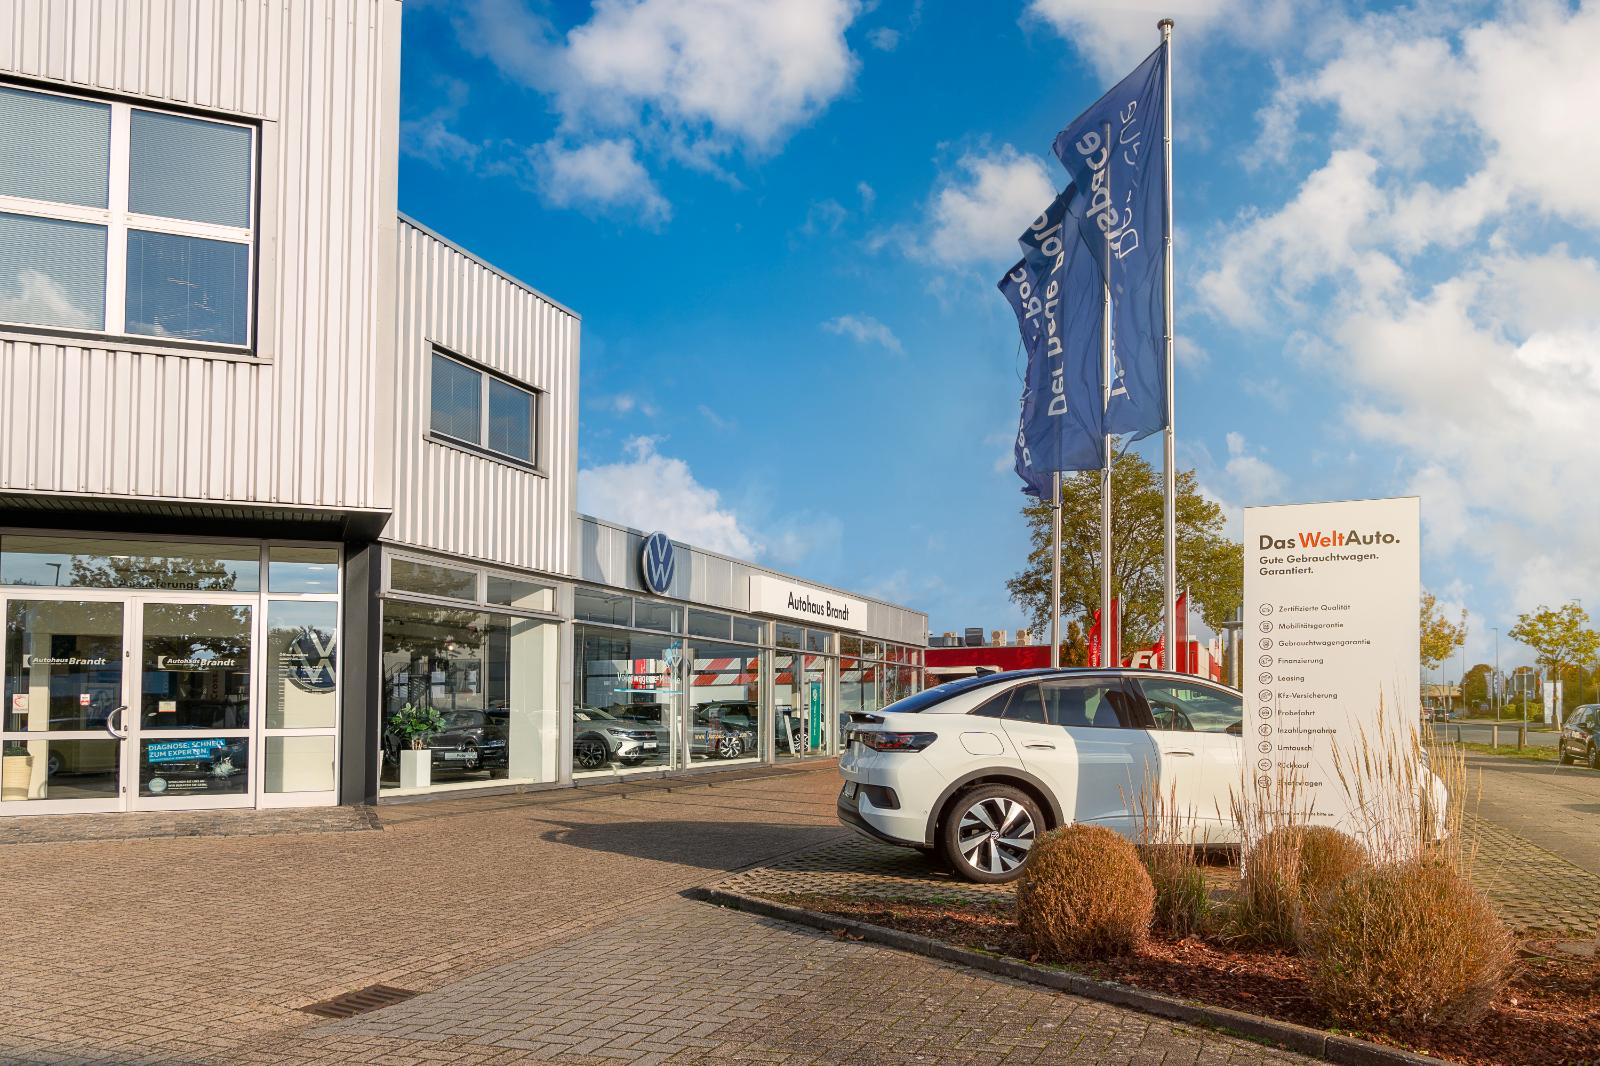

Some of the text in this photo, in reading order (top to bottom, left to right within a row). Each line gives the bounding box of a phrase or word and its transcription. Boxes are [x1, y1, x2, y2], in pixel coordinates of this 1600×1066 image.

[1259, 529, 1401, 550] Das WeltAuto.
[1259, 552, 1380, 565] Gute Gebrauchtwagen.
[1259, 566, 1314, 576] Garantiert.
[787, 591, 849, 621] Autohaus Brandt
[1278, 603, 1351, 613] Zertifizierte Qualität
[1278, 621, 1344, 631] Mobilitätsgarantie
[1278, 638, 1371, 649] Gebrauchtwagengarantie
[69, 657, 106, 665] Brandt
[200, 658, 235, 666] Brandt
[1277, 657, 1324, 666] Finanzierung
[1277, 674, 1305, 684] Leasing
[1277, 691, 1338, 702] Kfz-Versicherung
[1277, 709, 1316, 717] Probefahrt
[1277, 726, 1337, 735] Inzahlungnahme
[148, 742, 190, 751] DIAGNOSE:
[1277, 744, 1313, 752] Umtausch
